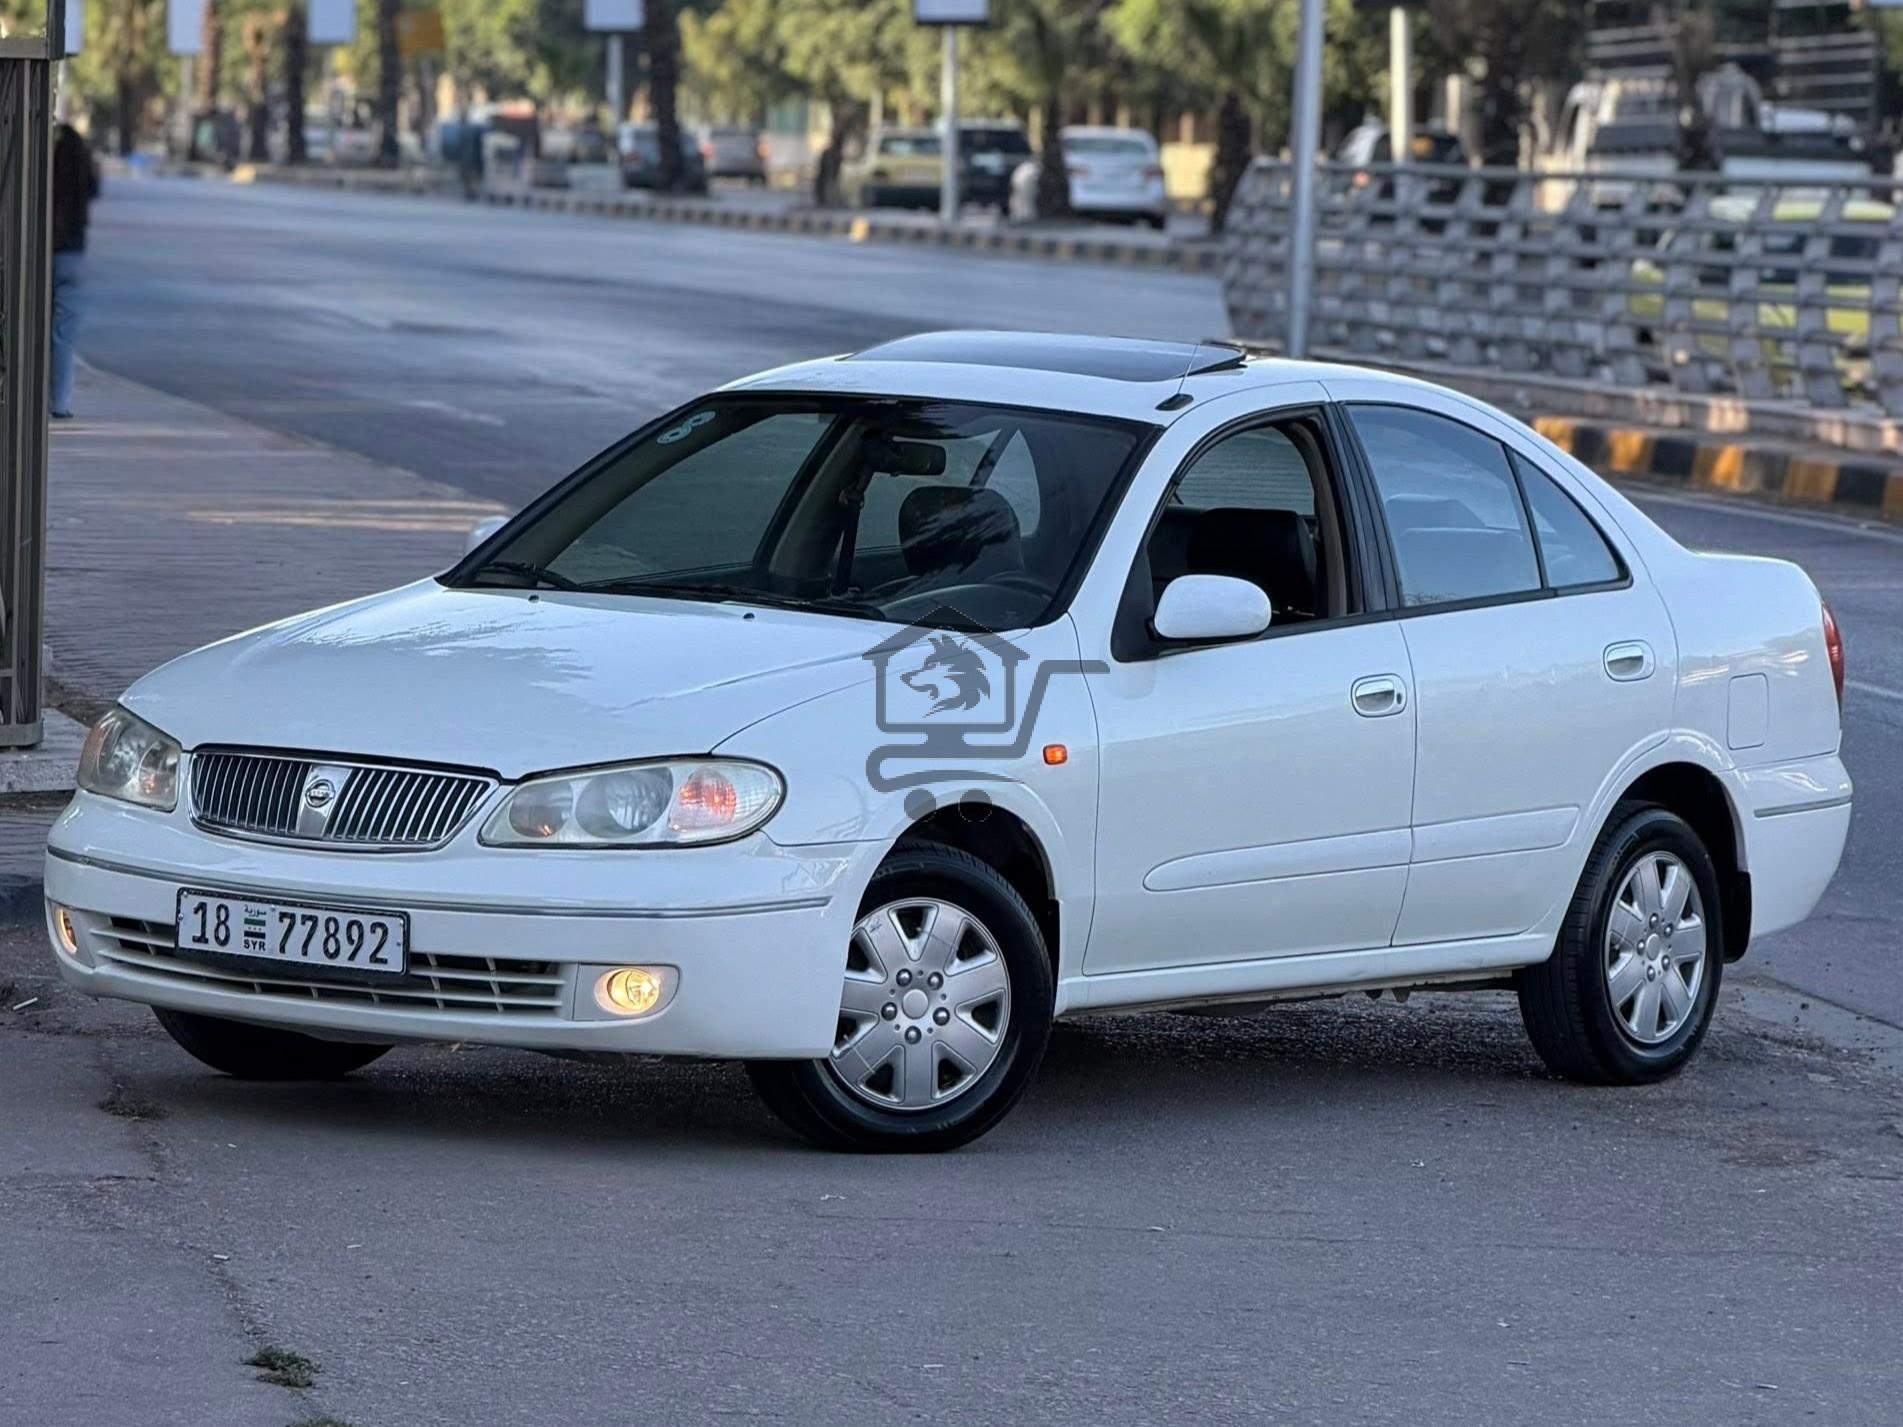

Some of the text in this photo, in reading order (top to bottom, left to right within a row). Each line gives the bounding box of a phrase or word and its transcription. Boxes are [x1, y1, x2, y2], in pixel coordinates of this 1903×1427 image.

[192, 901, 389, 965] 18 77892
[243, 939, 266, 951] SYR
